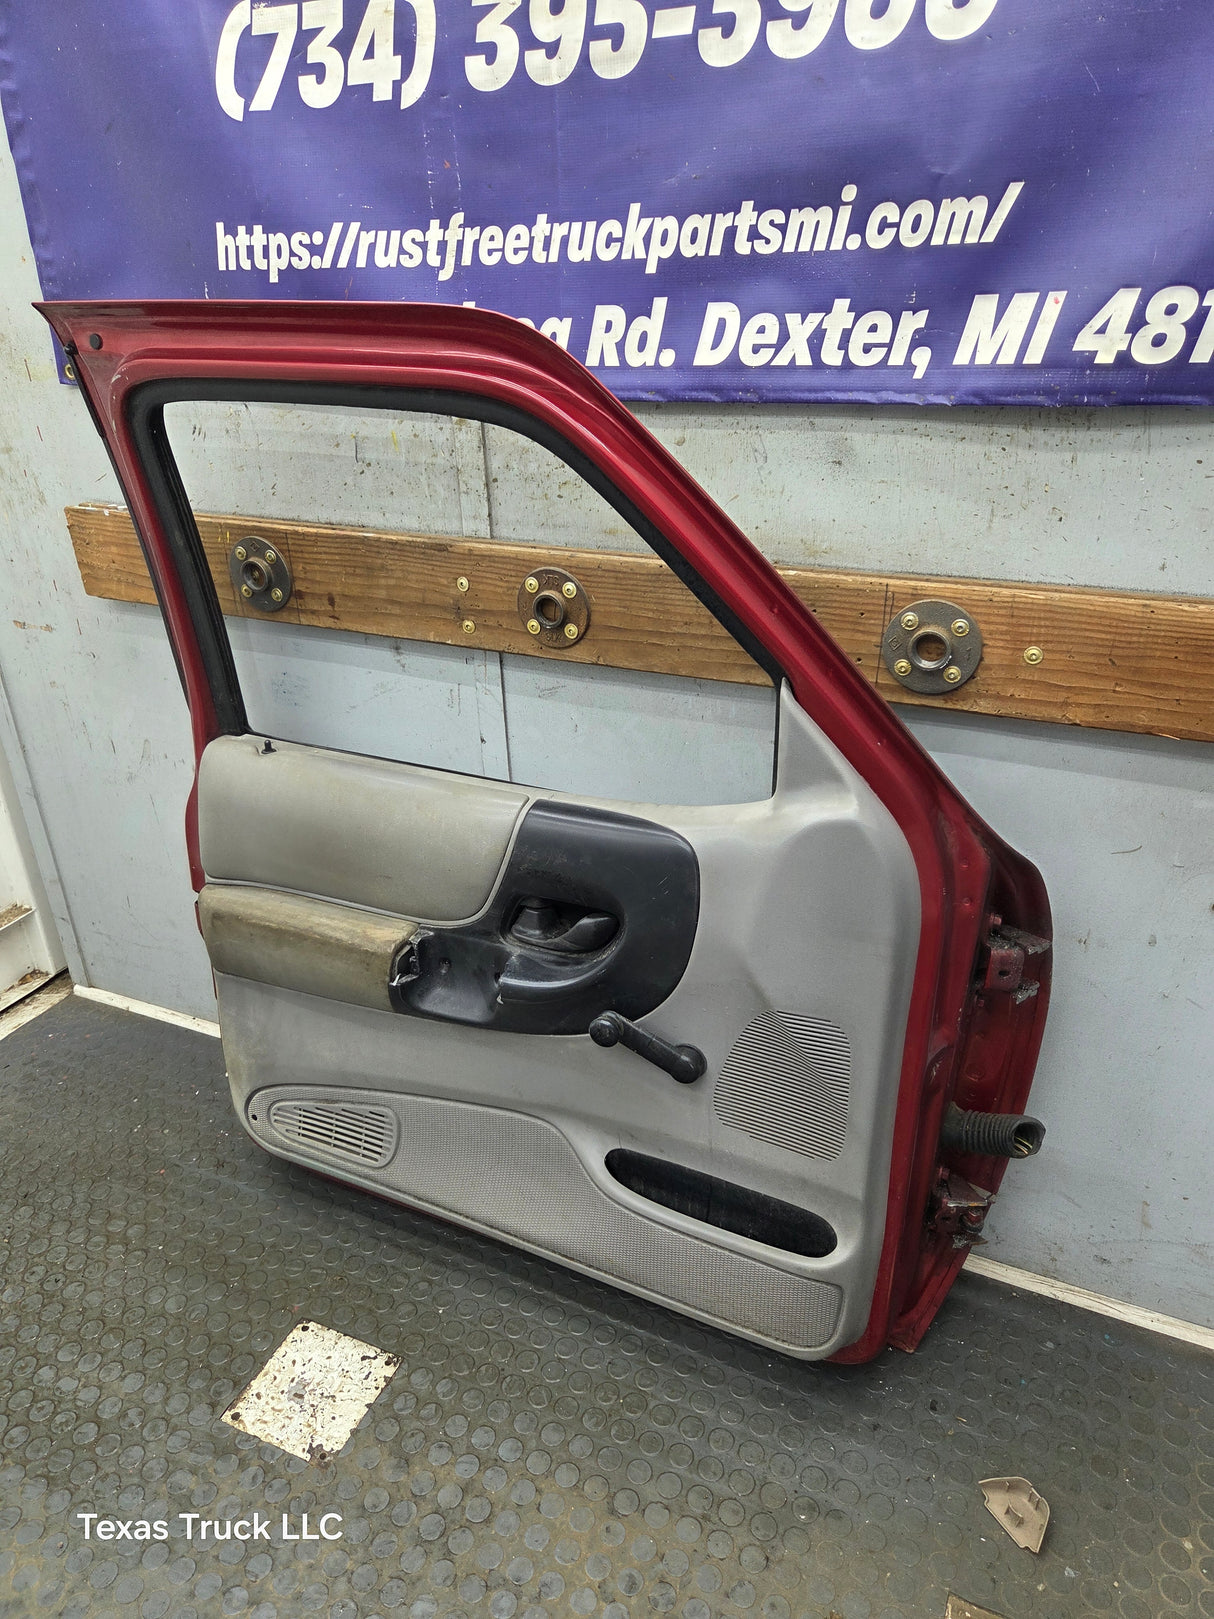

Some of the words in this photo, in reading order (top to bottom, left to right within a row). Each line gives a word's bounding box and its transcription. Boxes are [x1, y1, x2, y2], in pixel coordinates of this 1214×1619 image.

[215, 0, 437, 122] (734)
[216, 182, 1025, 284] https://rustfreetruckpartsmi.com/
[585, 297, 676, 368] Rd.
[693, 298, 932, 380] Dexter,
[952, 289, 1068, 366] MI
